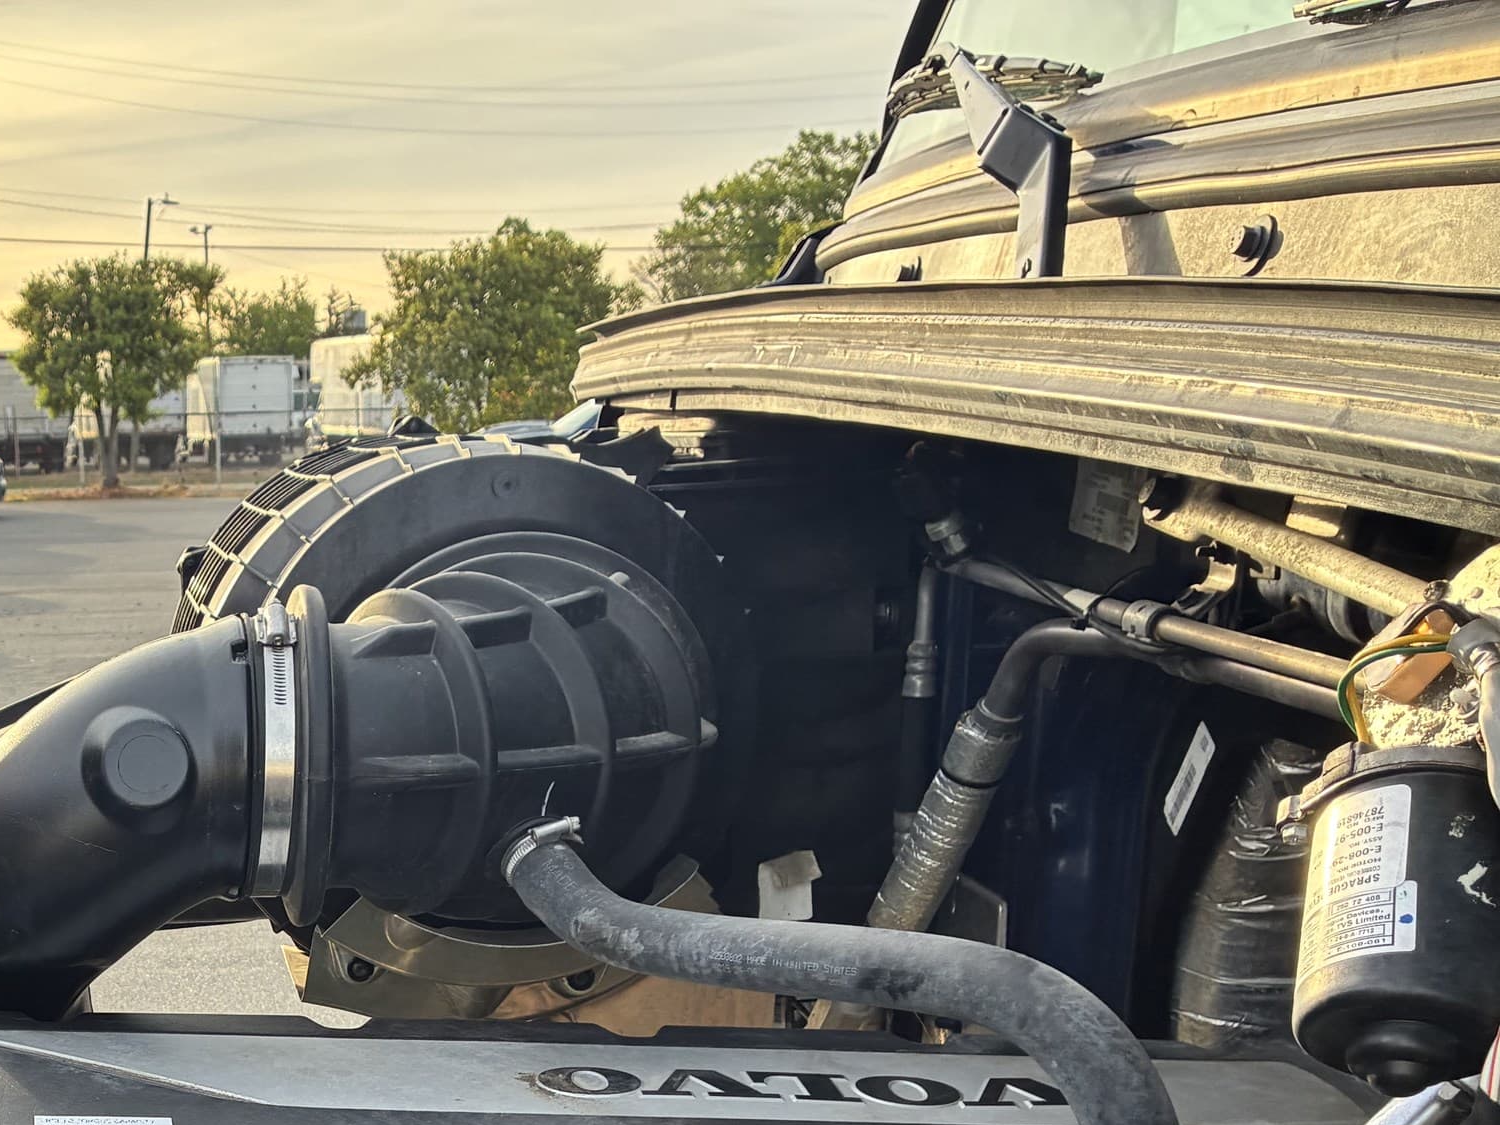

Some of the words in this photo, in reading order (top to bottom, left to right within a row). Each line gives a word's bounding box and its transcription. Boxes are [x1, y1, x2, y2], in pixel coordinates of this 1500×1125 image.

[1328, 873, 1381, 896] SPRAGUE
[1355, 913, 1391, 924] Limited
[536, 1065, 1070, 1108] VOLVO
